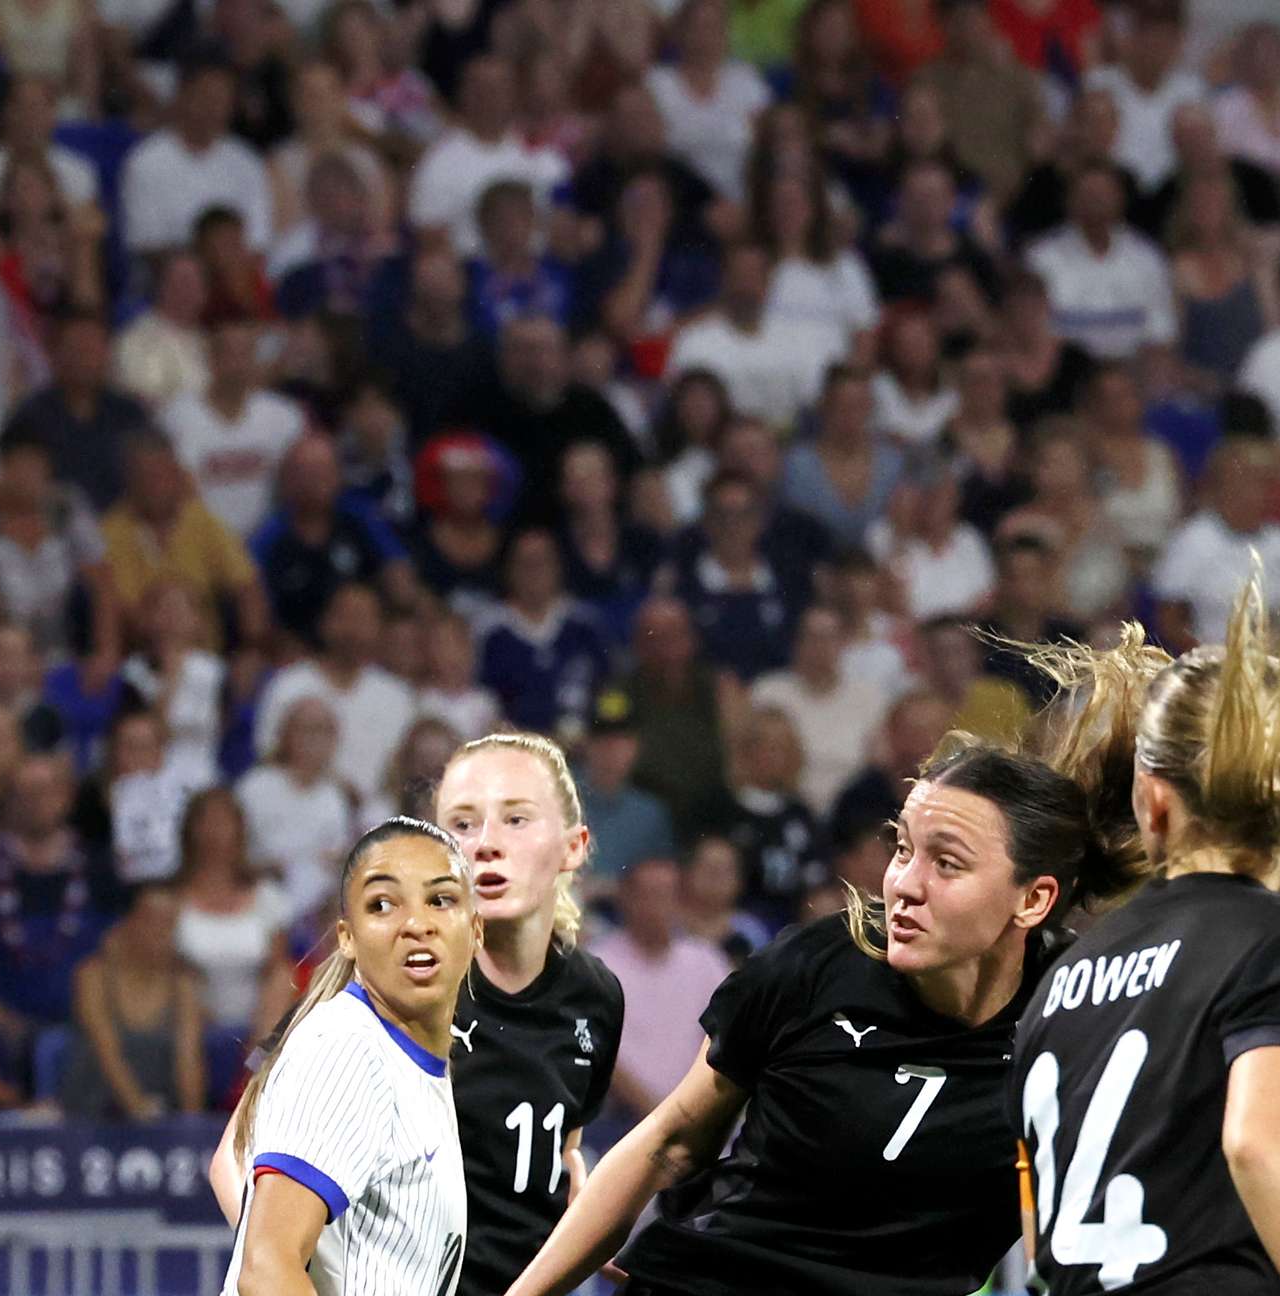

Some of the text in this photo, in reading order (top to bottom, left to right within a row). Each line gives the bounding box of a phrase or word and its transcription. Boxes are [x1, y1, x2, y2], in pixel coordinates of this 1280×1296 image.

[1042, 939, 1182, 1018] BOWEN
[505, 1101, 565, 1194] 11
[883, 1064, 947, 1161] 7
[1022, 1028, 1168, 1291] 14
